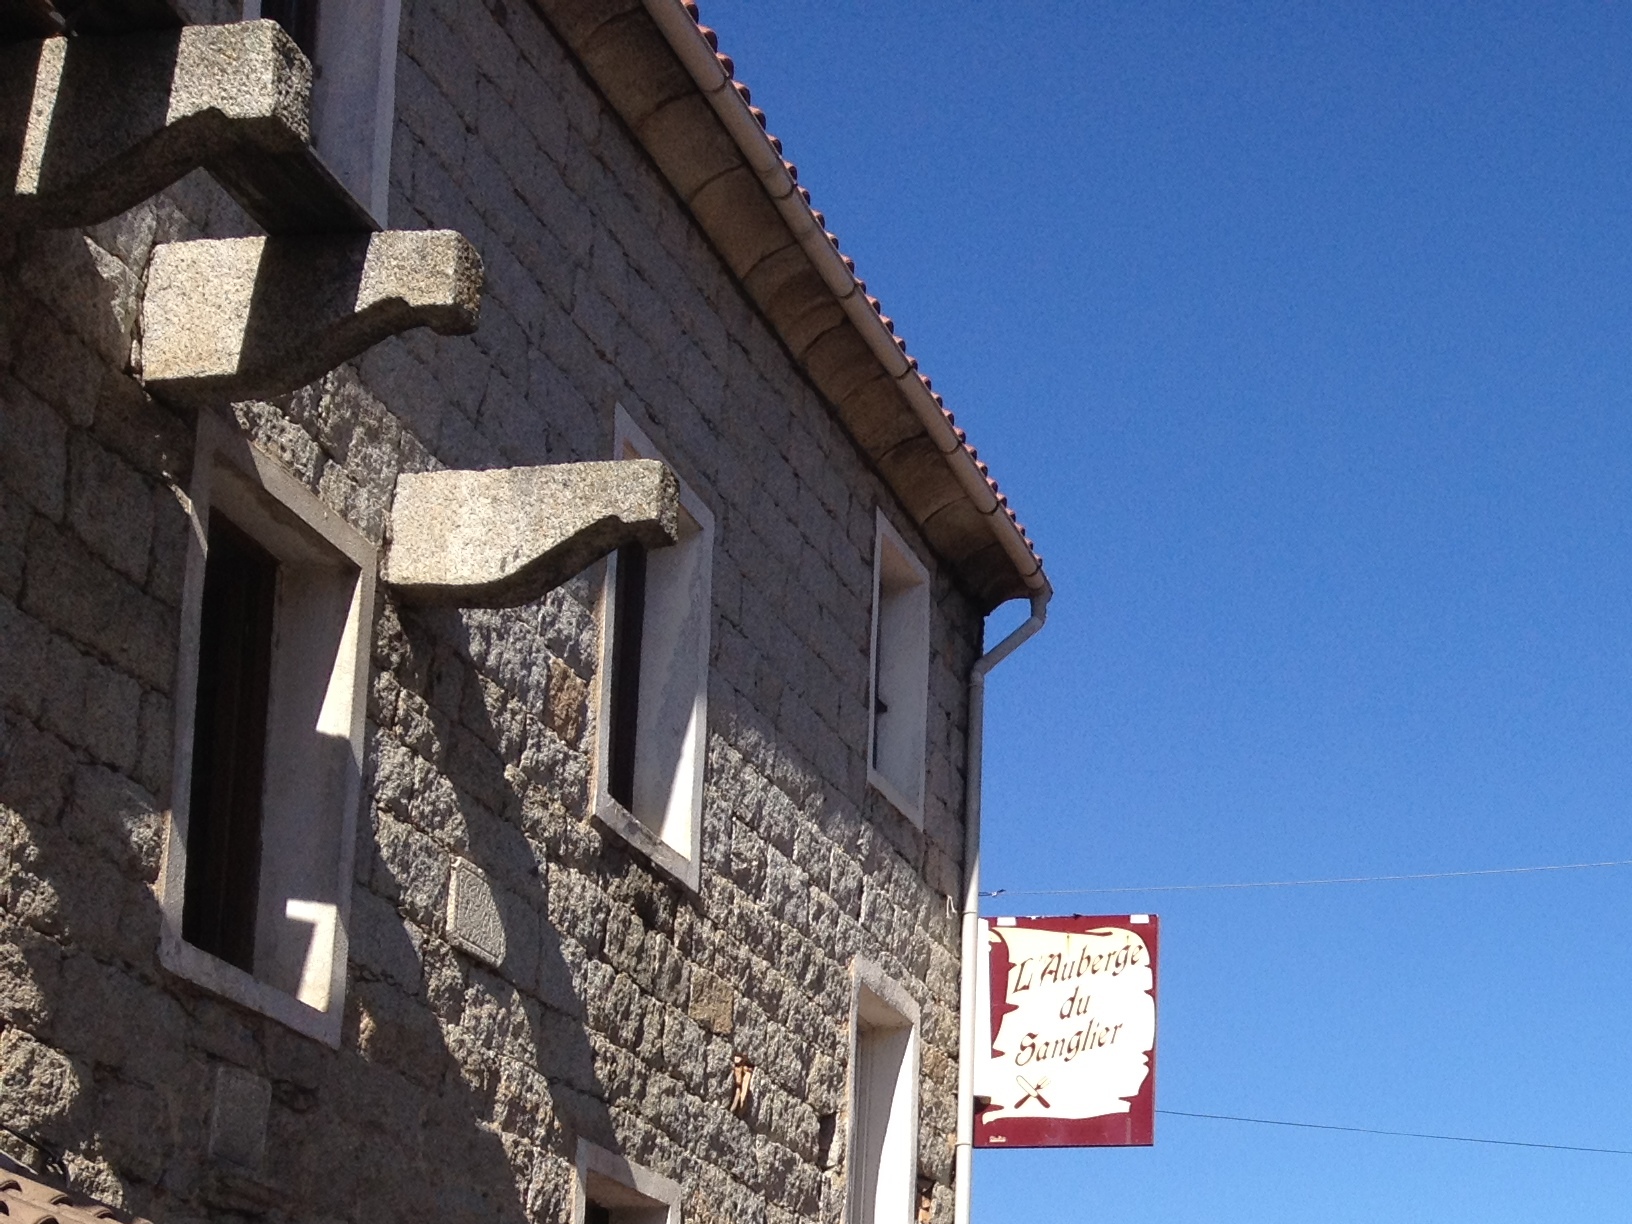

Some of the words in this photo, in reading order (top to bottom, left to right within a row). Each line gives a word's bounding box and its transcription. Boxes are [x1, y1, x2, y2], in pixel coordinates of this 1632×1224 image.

[1013, 944, 1144, 994] L'Auberge
[1059, 986, 1091, 1019] du
[1015, 1017, 1124, 1066] Sanglier
